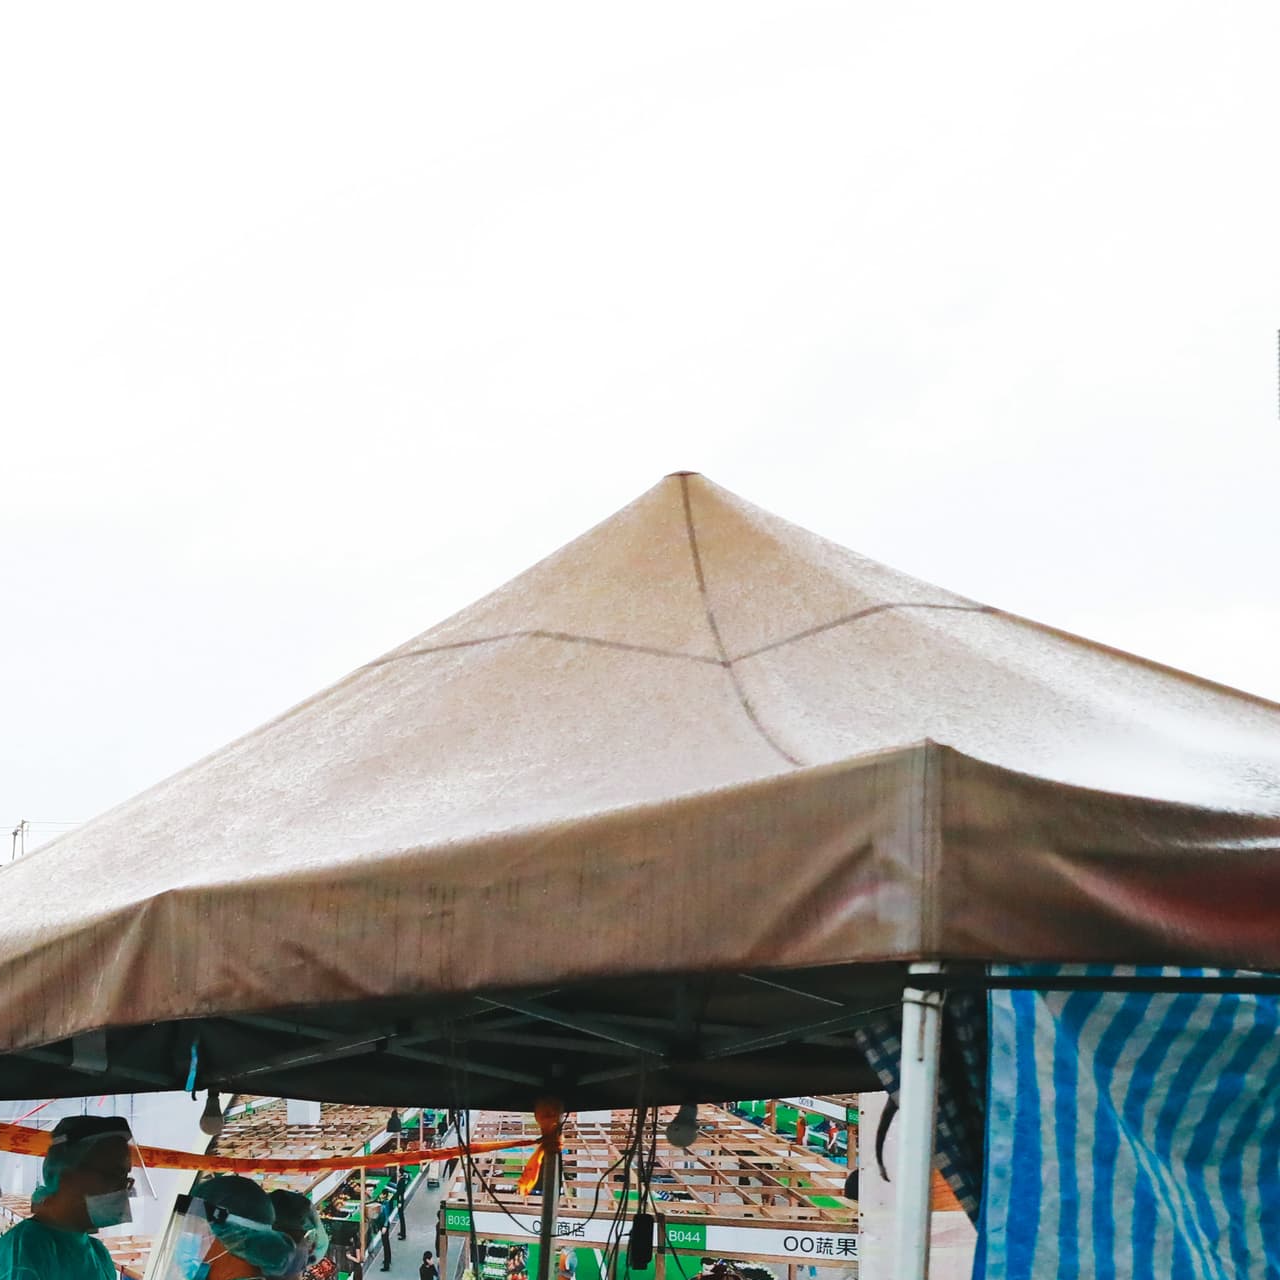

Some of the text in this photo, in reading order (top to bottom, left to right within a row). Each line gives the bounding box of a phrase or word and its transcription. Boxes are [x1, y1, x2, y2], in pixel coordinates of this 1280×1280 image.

[448, 1215, 470, 1226] B032
[532, 1220, 586, 1238] O商店
[668, 1230, 701, 1244] B044
